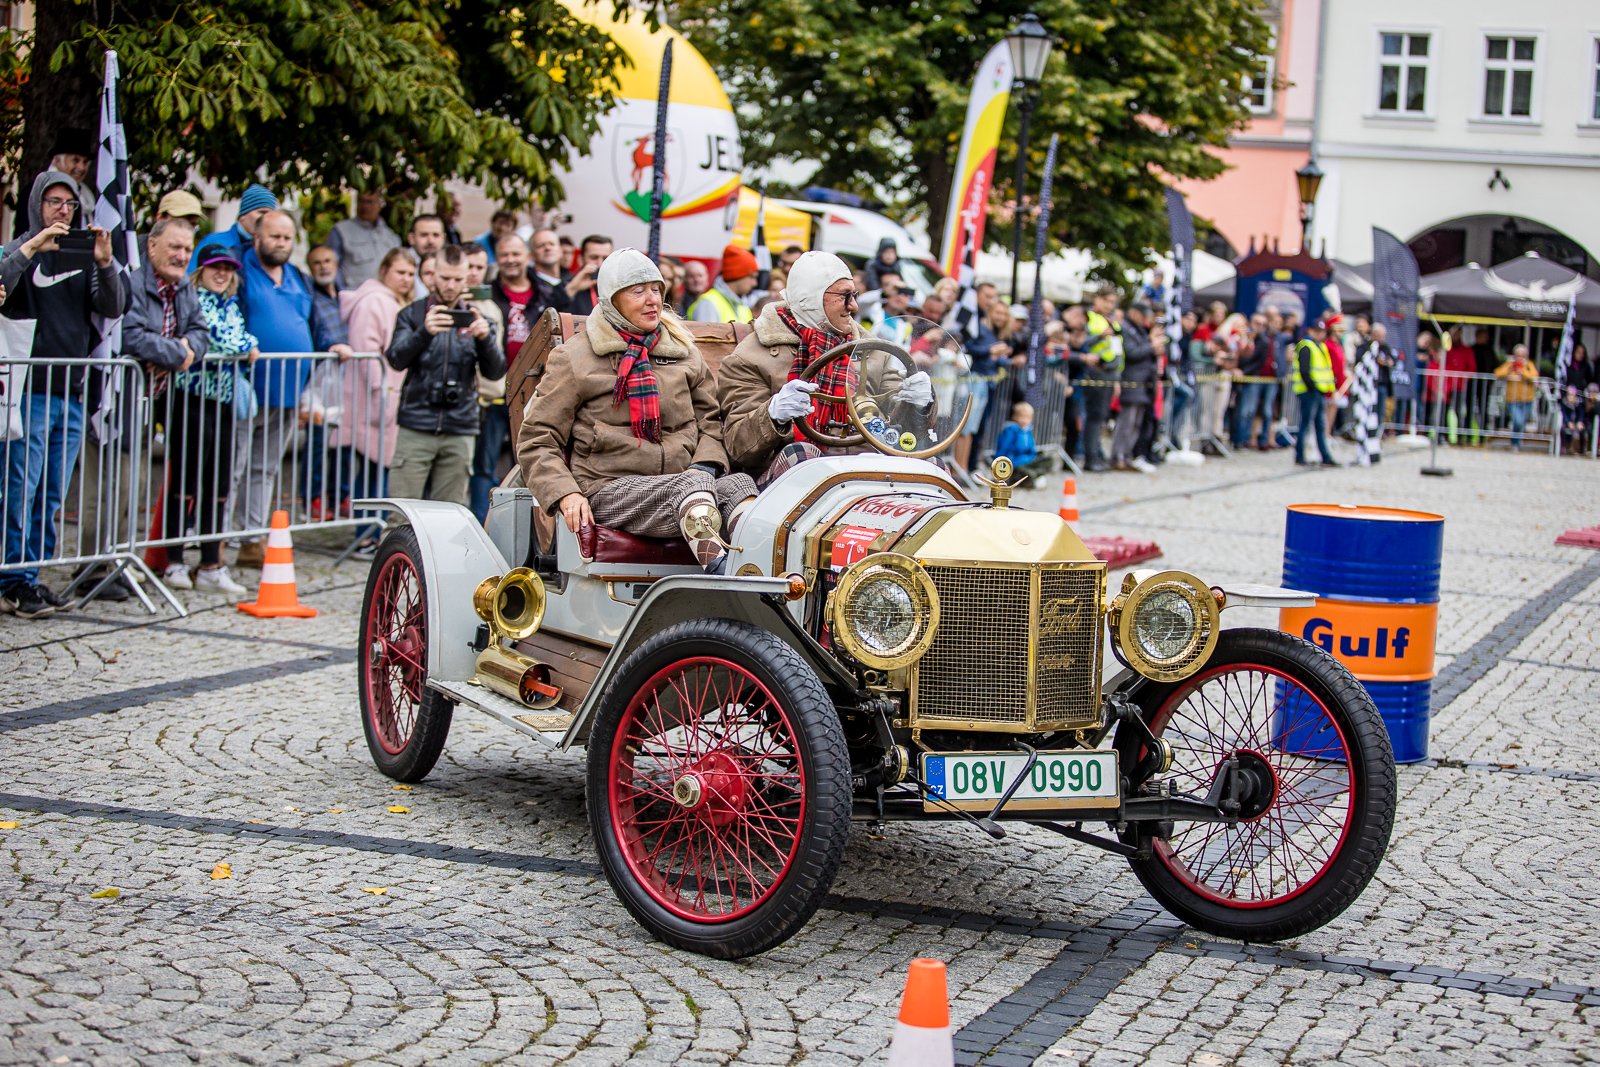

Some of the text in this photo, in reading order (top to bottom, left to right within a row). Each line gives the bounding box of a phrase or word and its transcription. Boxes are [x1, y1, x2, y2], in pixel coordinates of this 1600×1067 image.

[1302, 617, 1410, 659] Gulf
[930, 784, 944, 795] CZ
[952, 759, 1102, 794] 08V 0990
